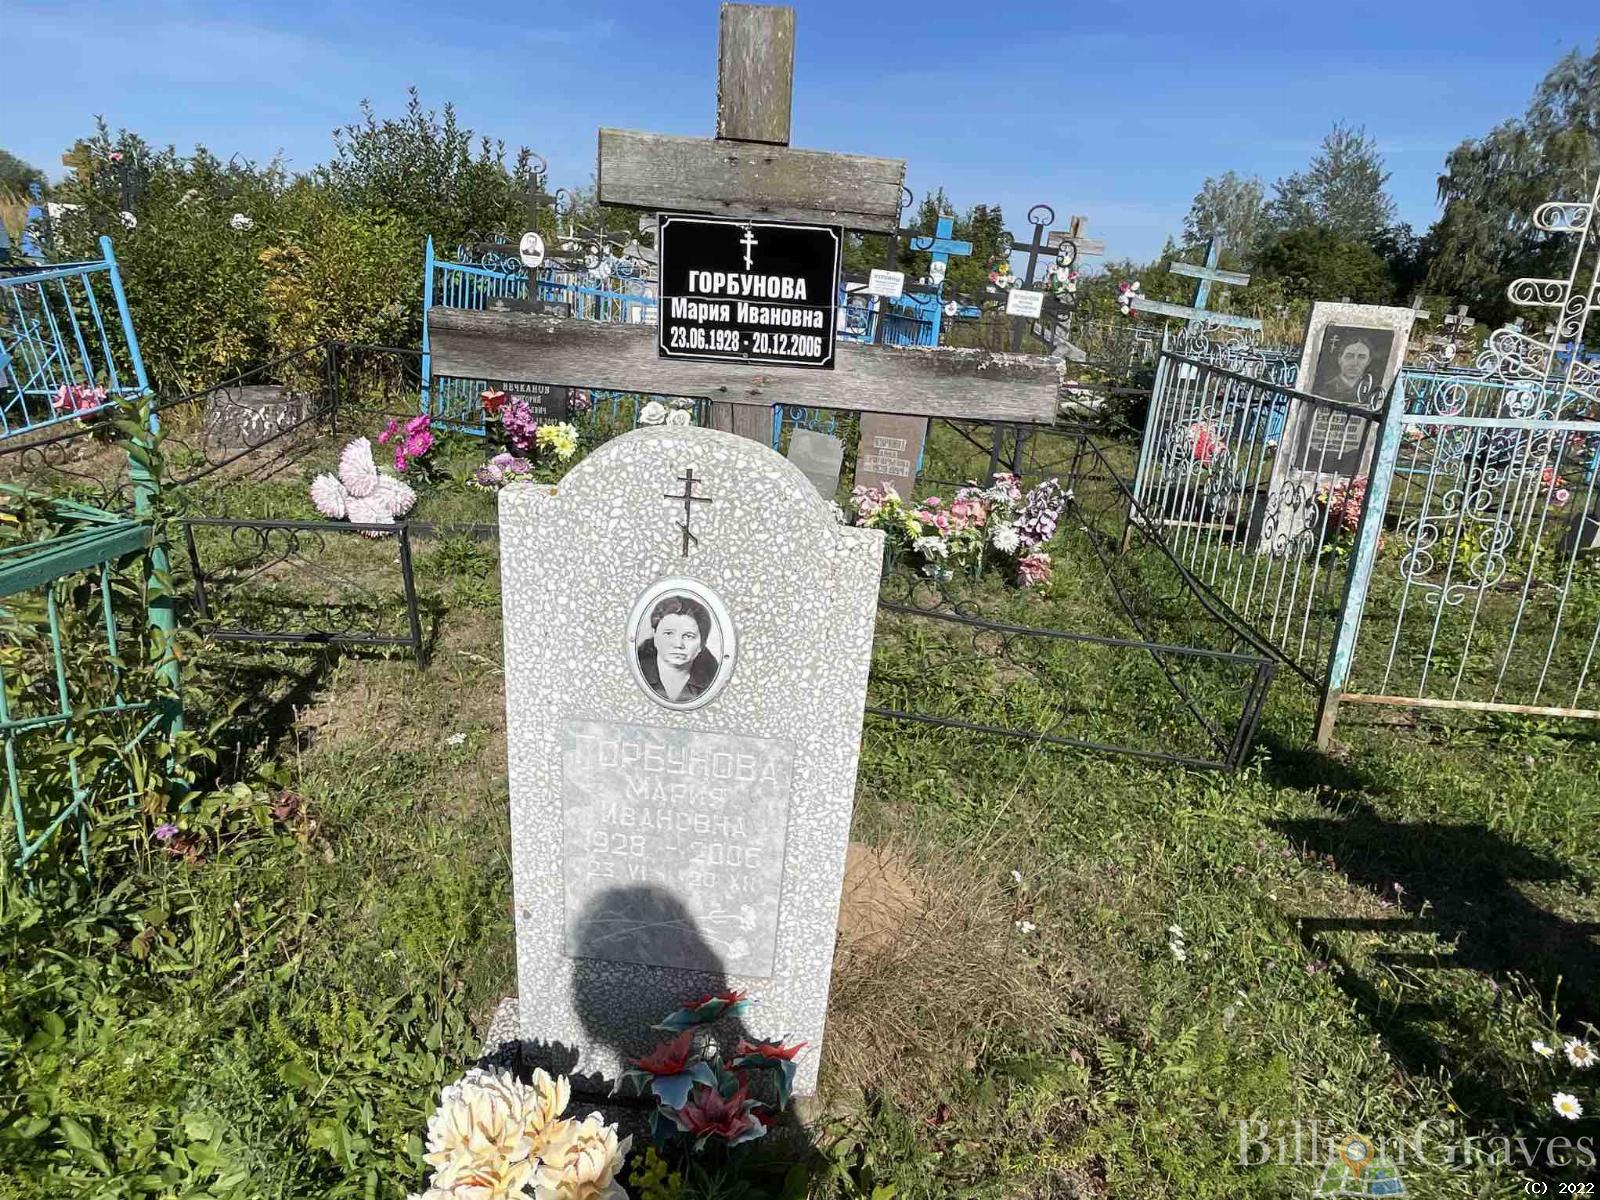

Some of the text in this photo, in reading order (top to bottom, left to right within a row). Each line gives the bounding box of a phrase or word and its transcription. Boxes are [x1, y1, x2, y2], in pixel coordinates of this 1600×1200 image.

[688, 270, 807, 300] ГОРБУНОВА
[670, 296, 824, 329] Мария Ивановна
[670, 326, 740, 352] 23.06.1928
[751, 332, 823, 358] 20.12.2006
[576, 735, 782, 788] ГОРБУНОВА
[625, 775, 728, 808] МАРИЯ
[600, 801, 747, 839] ИВАНОВНА
[689, 841, 763, 869] 2006
